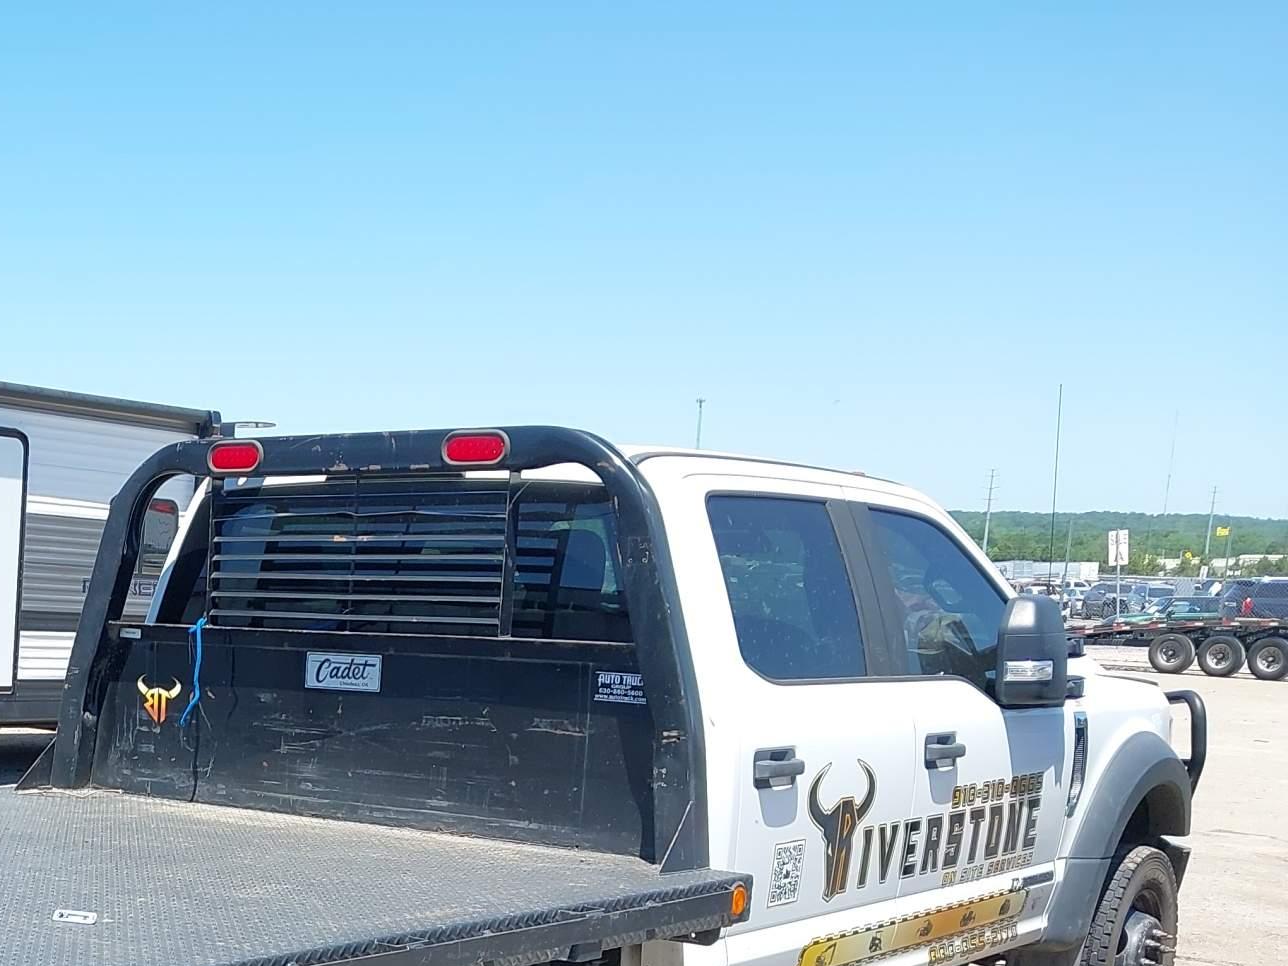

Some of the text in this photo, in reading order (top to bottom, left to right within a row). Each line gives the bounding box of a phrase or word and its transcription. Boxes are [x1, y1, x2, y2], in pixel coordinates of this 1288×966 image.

[315, 658, 376, 683] Cadet
[598, 674, 644, 687] AUTO TRUC
[941, 851, 1034, 887] ON SITE SERVICES
